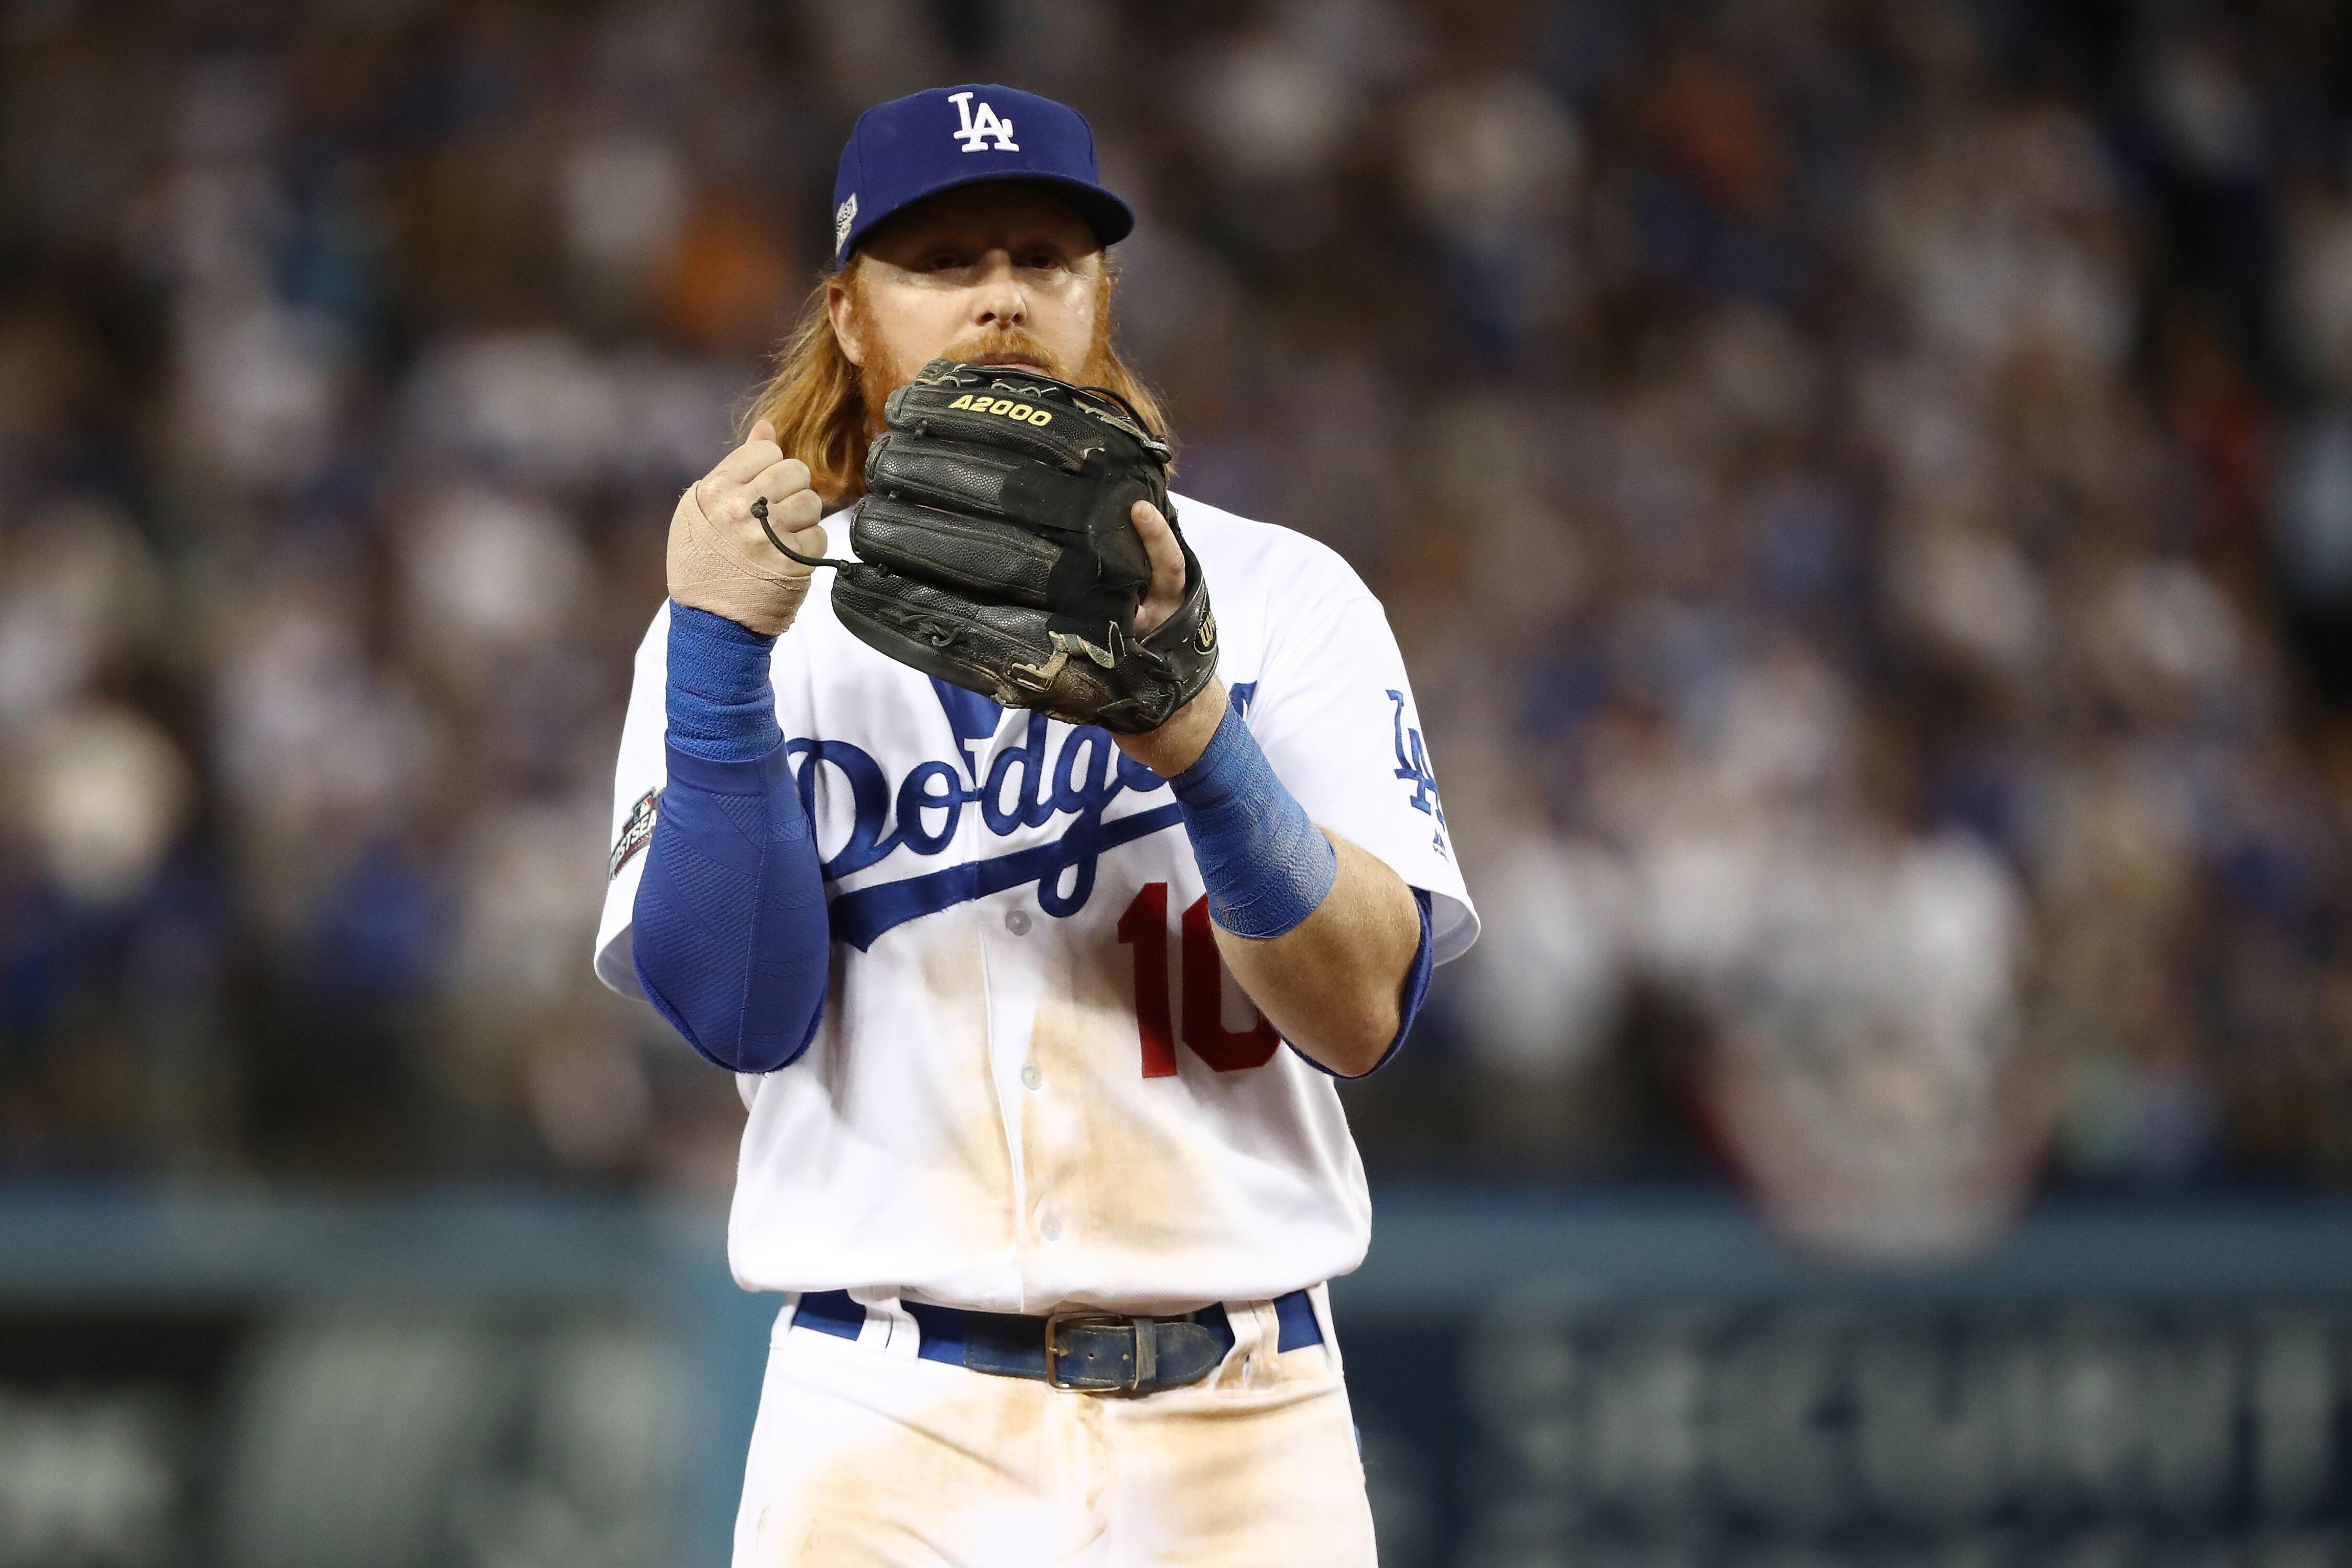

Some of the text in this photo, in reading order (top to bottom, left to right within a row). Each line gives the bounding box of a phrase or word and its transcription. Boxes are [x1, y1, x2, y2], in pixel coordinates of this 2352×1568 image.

[948, 91, 1020, 153] LA
[948, 394, 1052, 427] A2000
[1117, 881, 1281, 1079] 10
